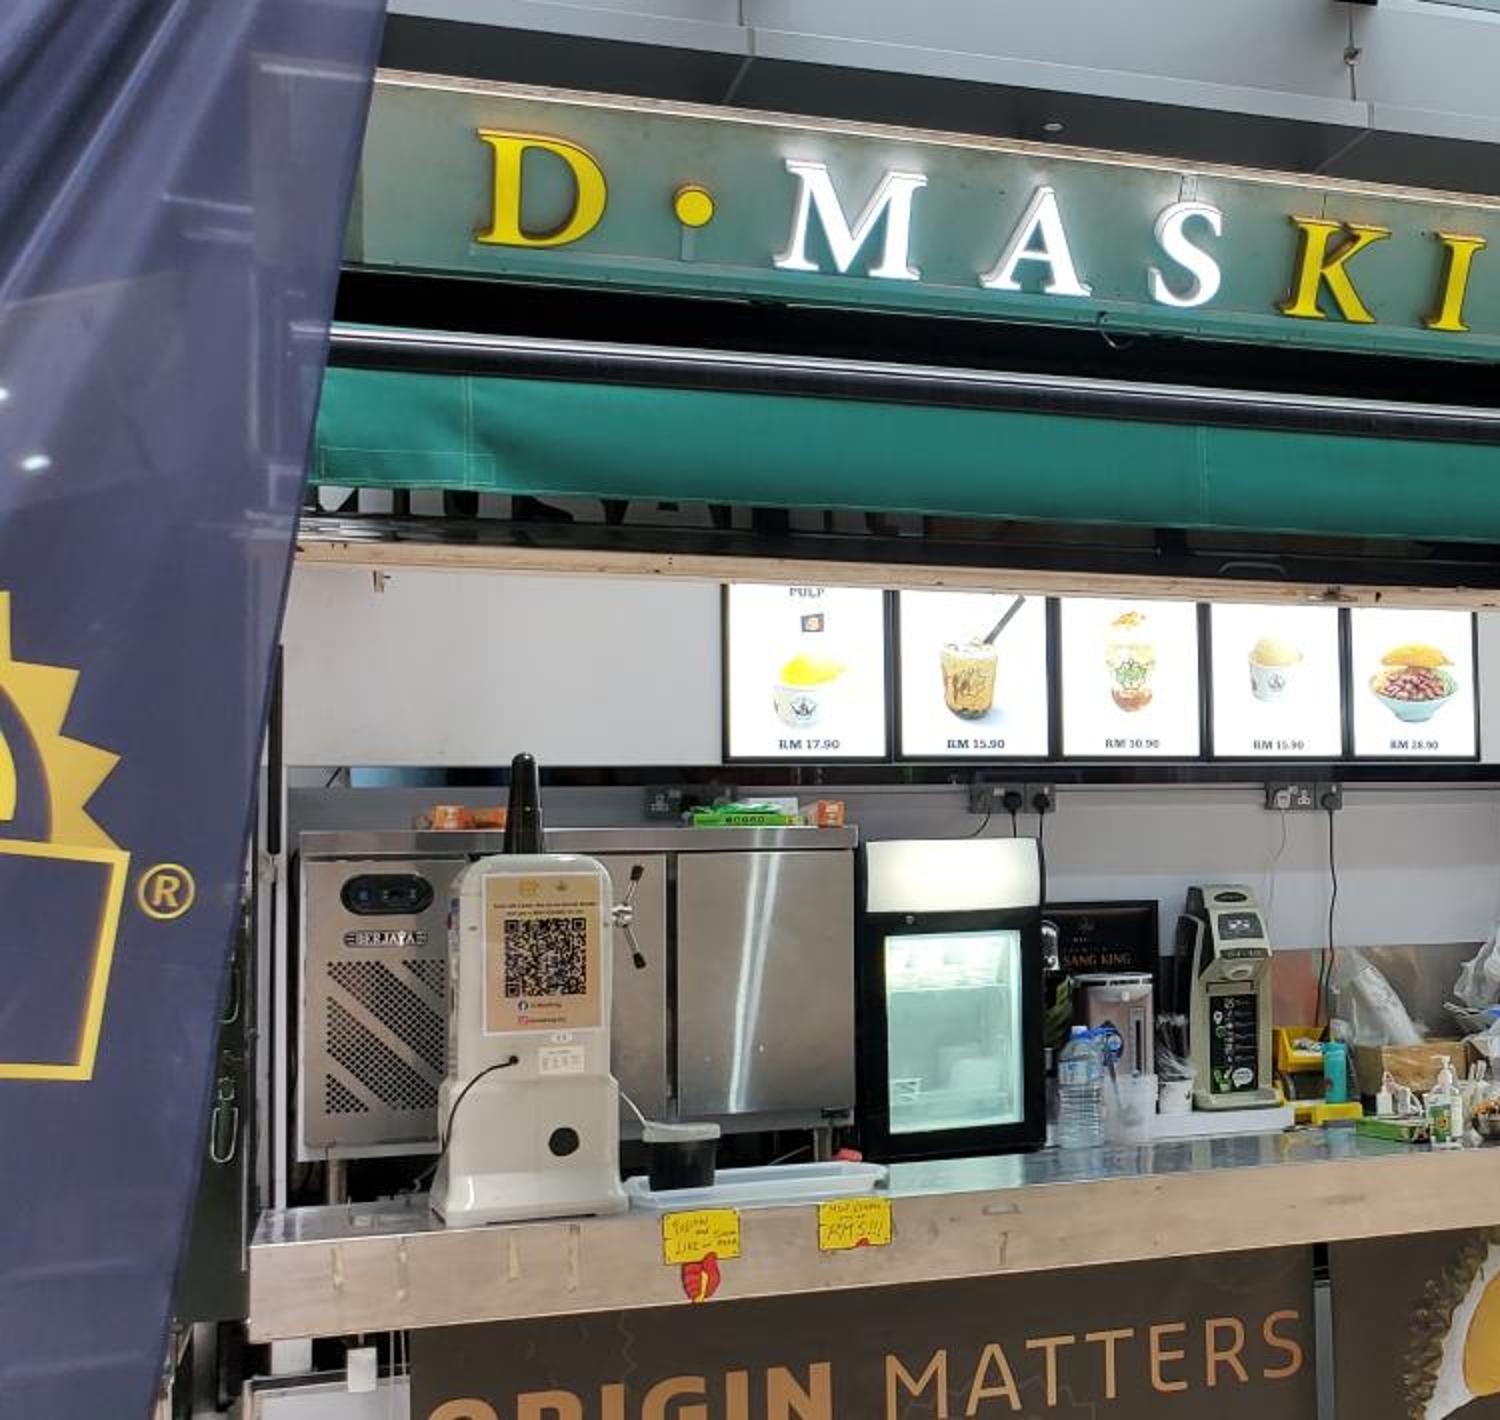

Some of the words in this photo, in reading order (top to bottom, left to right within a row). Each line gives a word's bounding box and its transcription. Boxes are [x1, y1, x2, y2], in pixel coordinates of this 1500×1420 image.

[779, 739, 802, 750] RM
[427, 1362, 832, 1420] IGIN
[884, 1309, 1303, 1420] MATTERS
